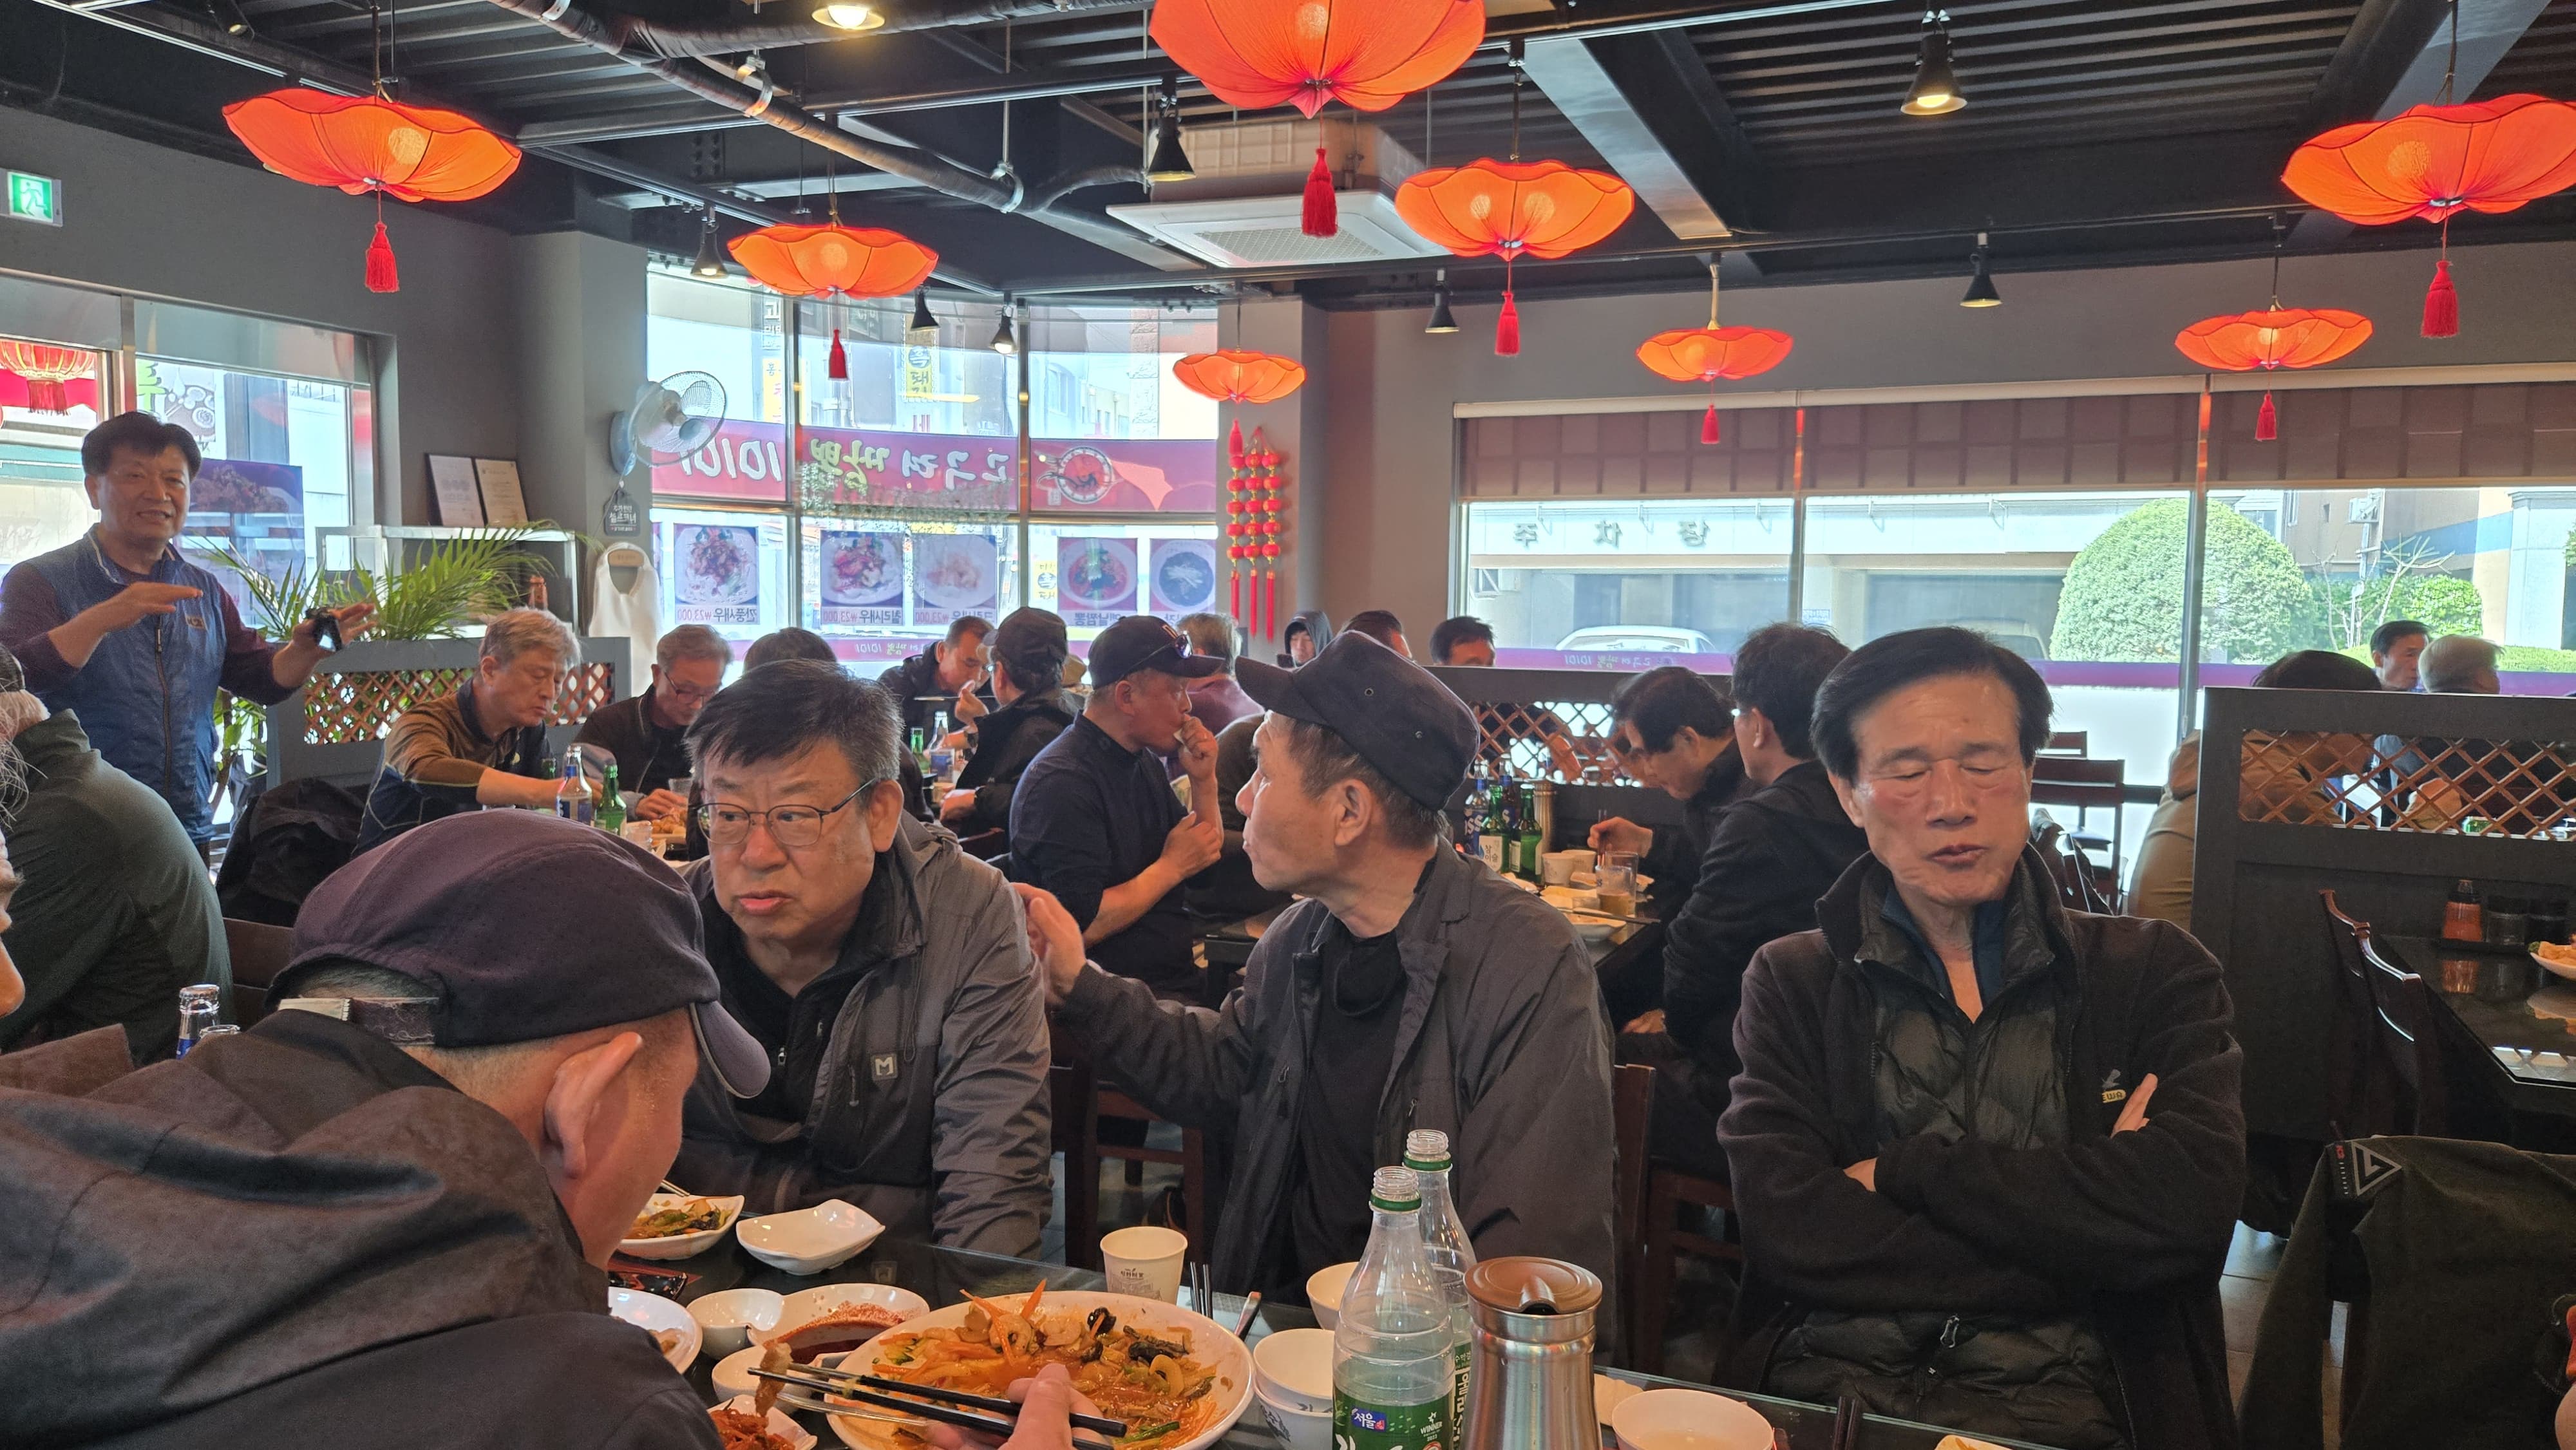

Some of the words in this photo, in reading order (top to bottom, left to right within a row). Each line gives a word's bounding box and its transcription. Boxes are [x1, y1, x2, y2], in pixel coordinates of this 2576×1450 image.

[875, 1056, 895, 1076] M
[1354, 1413, 1376, 1429] 서울
[1420, 1421, 1443, 1435] WINNER
